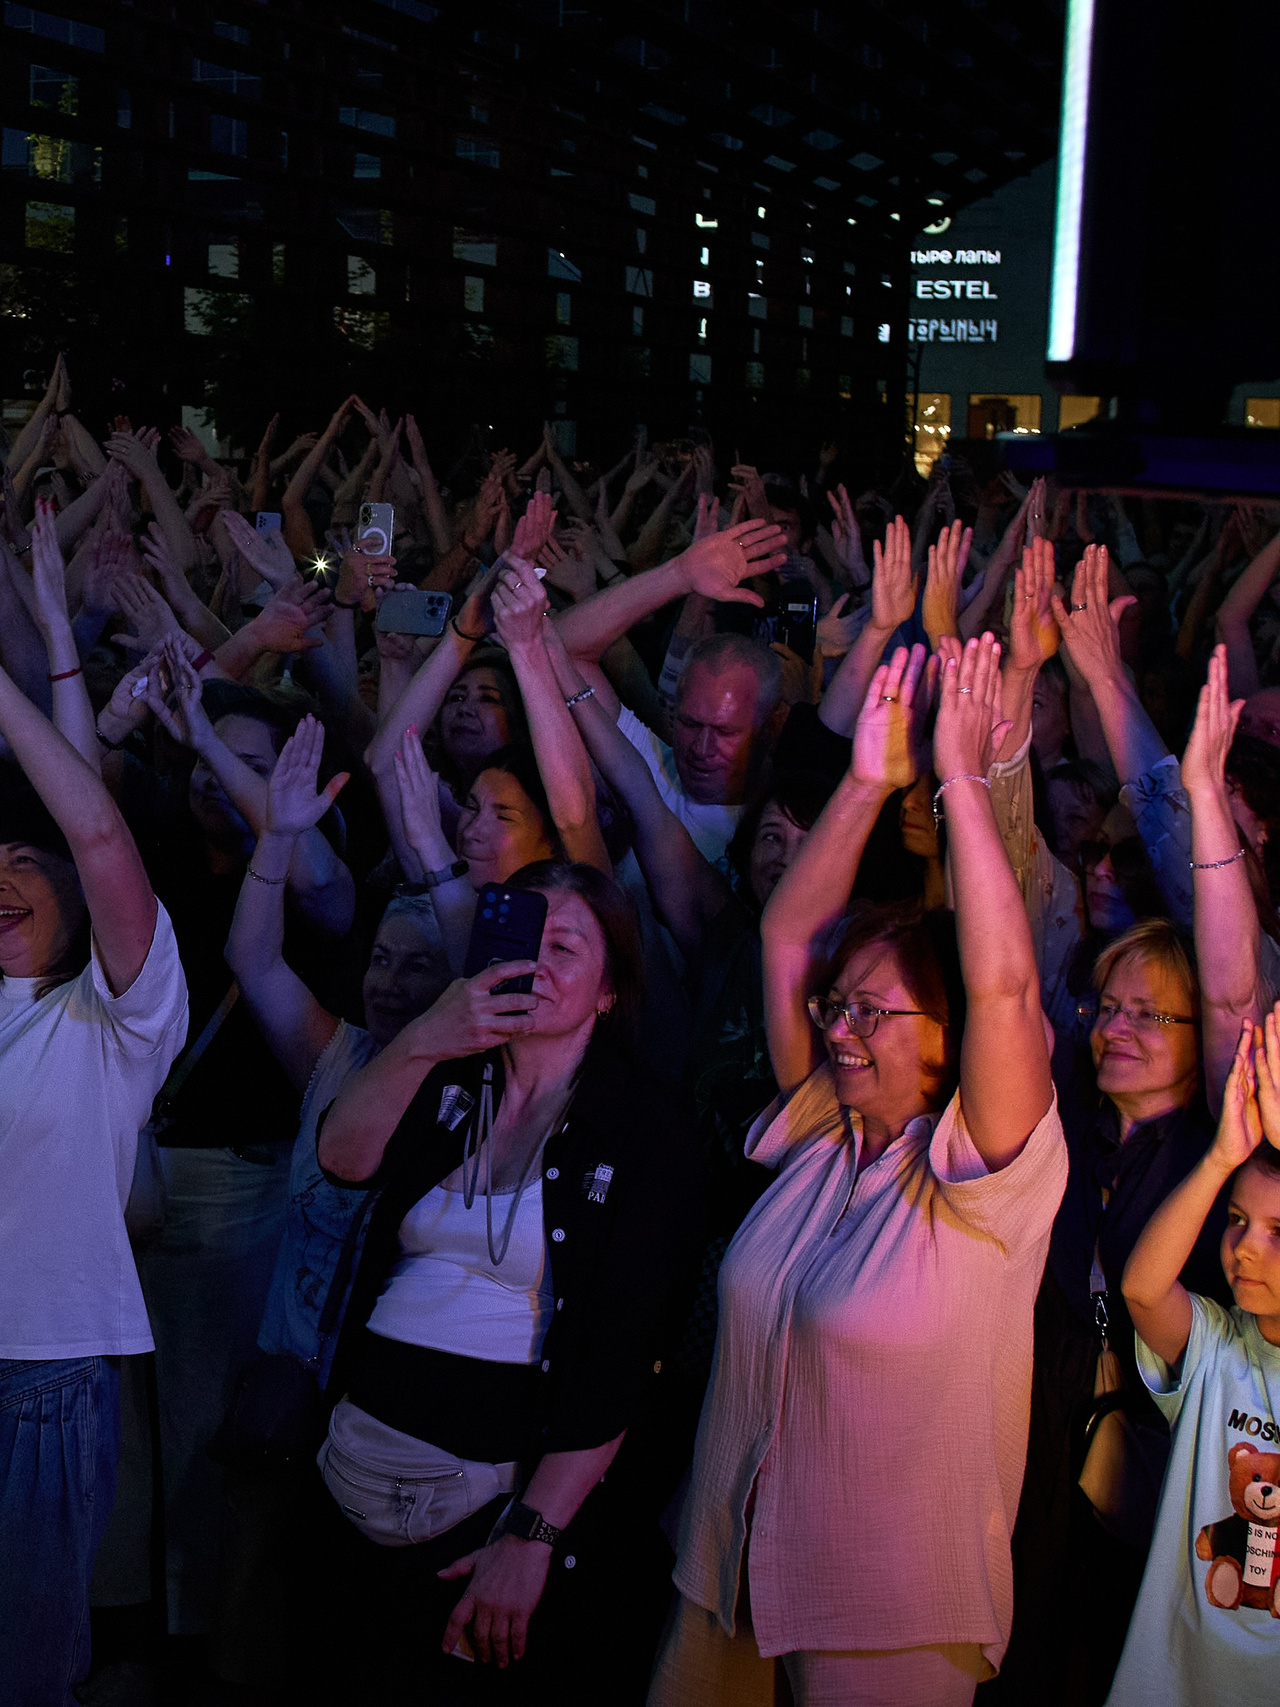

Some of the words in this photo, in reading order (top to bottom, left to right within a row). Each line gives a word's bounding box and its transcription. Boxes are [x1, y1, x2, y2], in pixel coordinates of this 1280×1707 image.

[916, 280, 998, 299] ESTEL
[1228, 1409, 1280, 1444] MOS
[1250, 1565, 1267, 1575] TOY
